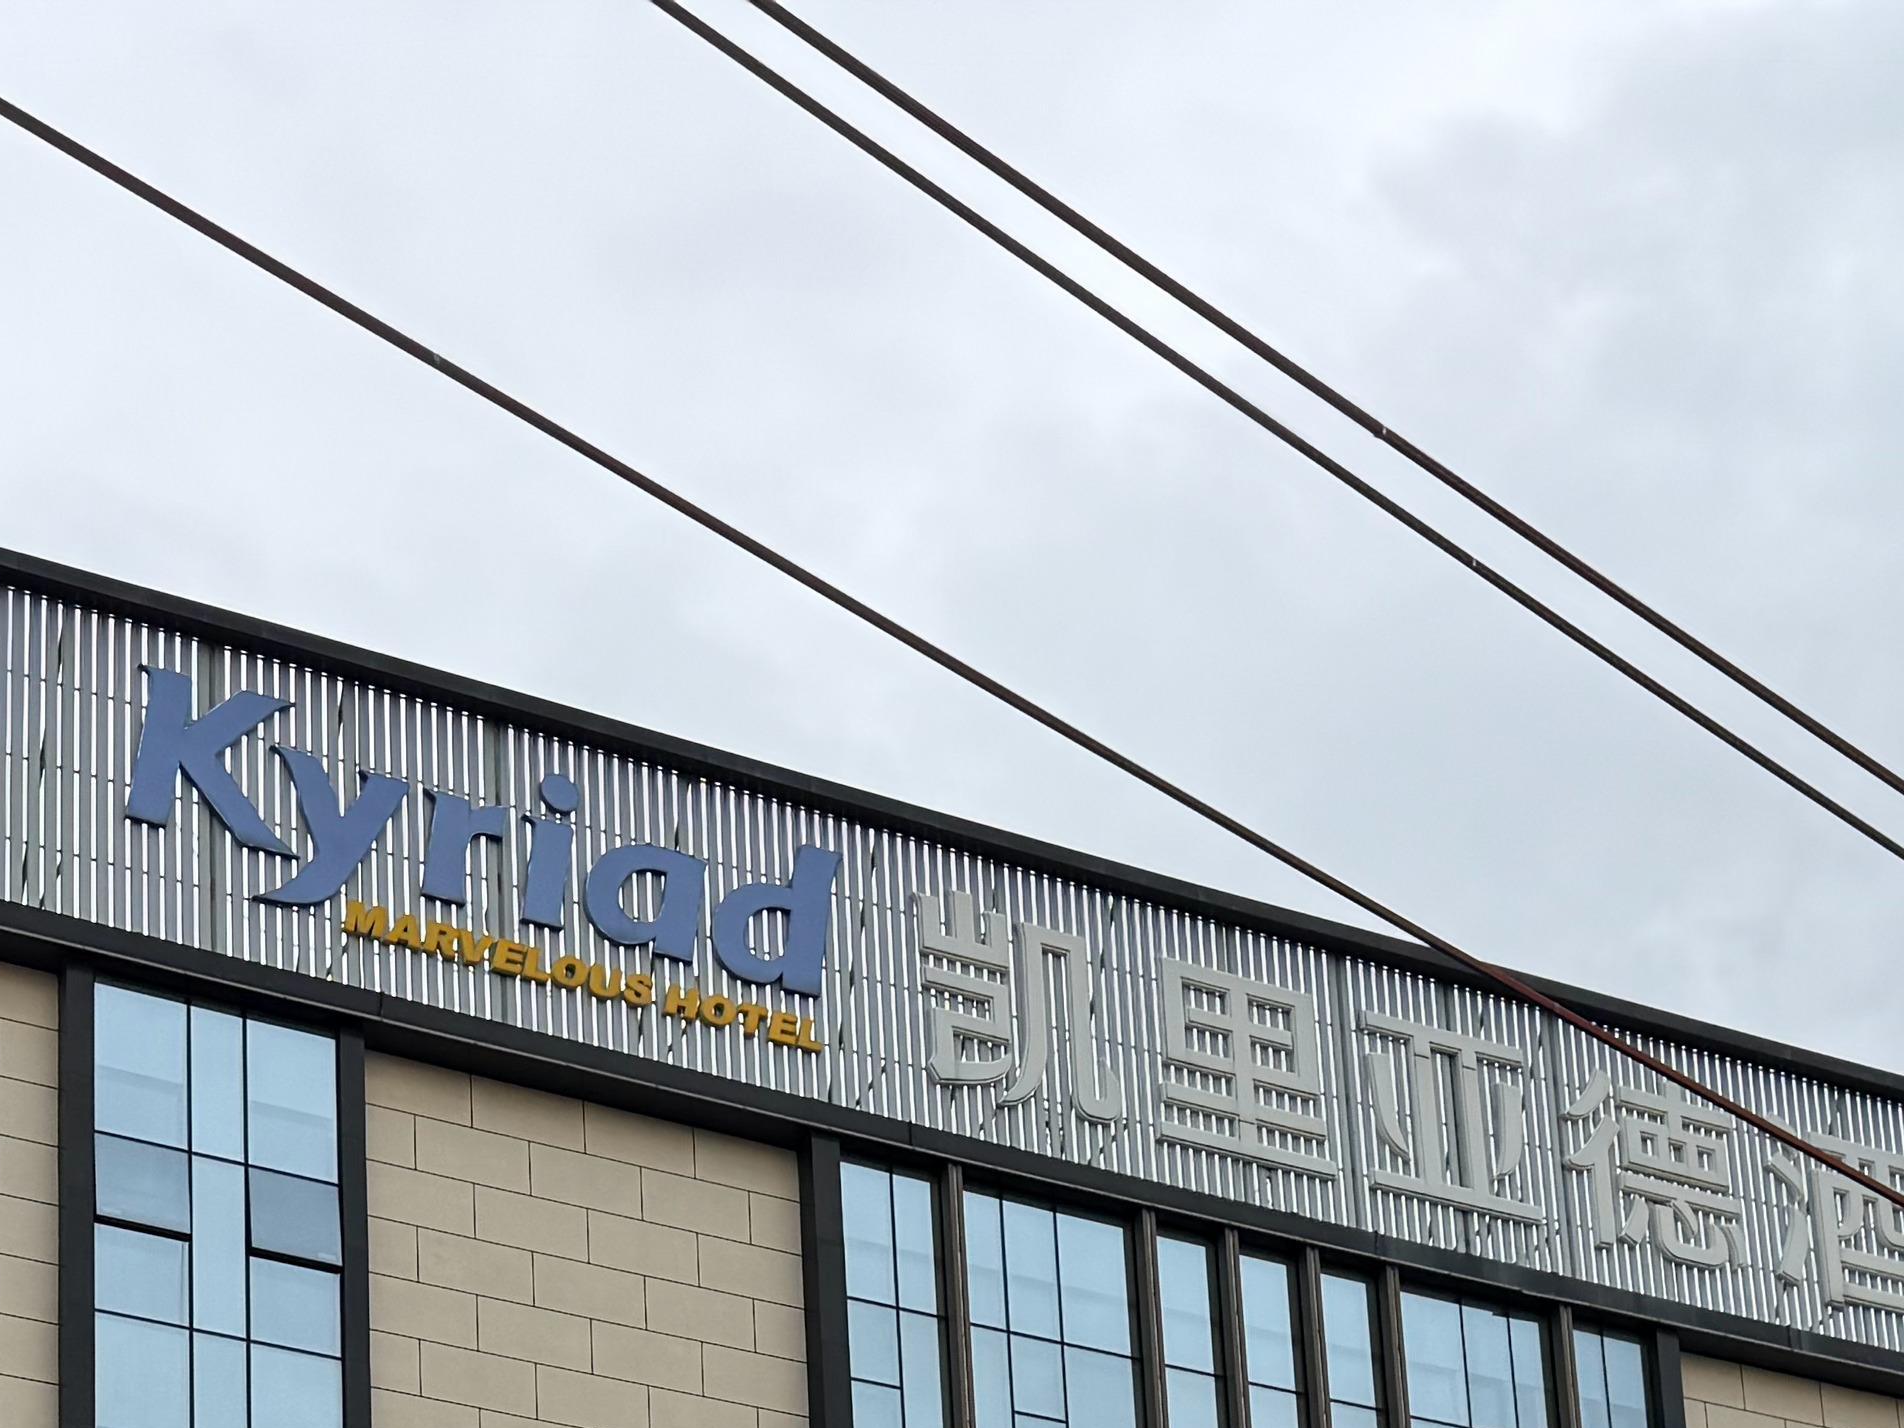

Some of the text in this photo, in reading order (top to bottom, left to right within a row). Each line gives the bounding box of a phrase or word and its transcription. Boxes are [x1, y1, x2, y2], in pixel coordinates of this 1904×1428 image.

[123, 663, 844, 998] Kyriad
[342, 900, 823, 1054] MARVELOUS HOTEL
